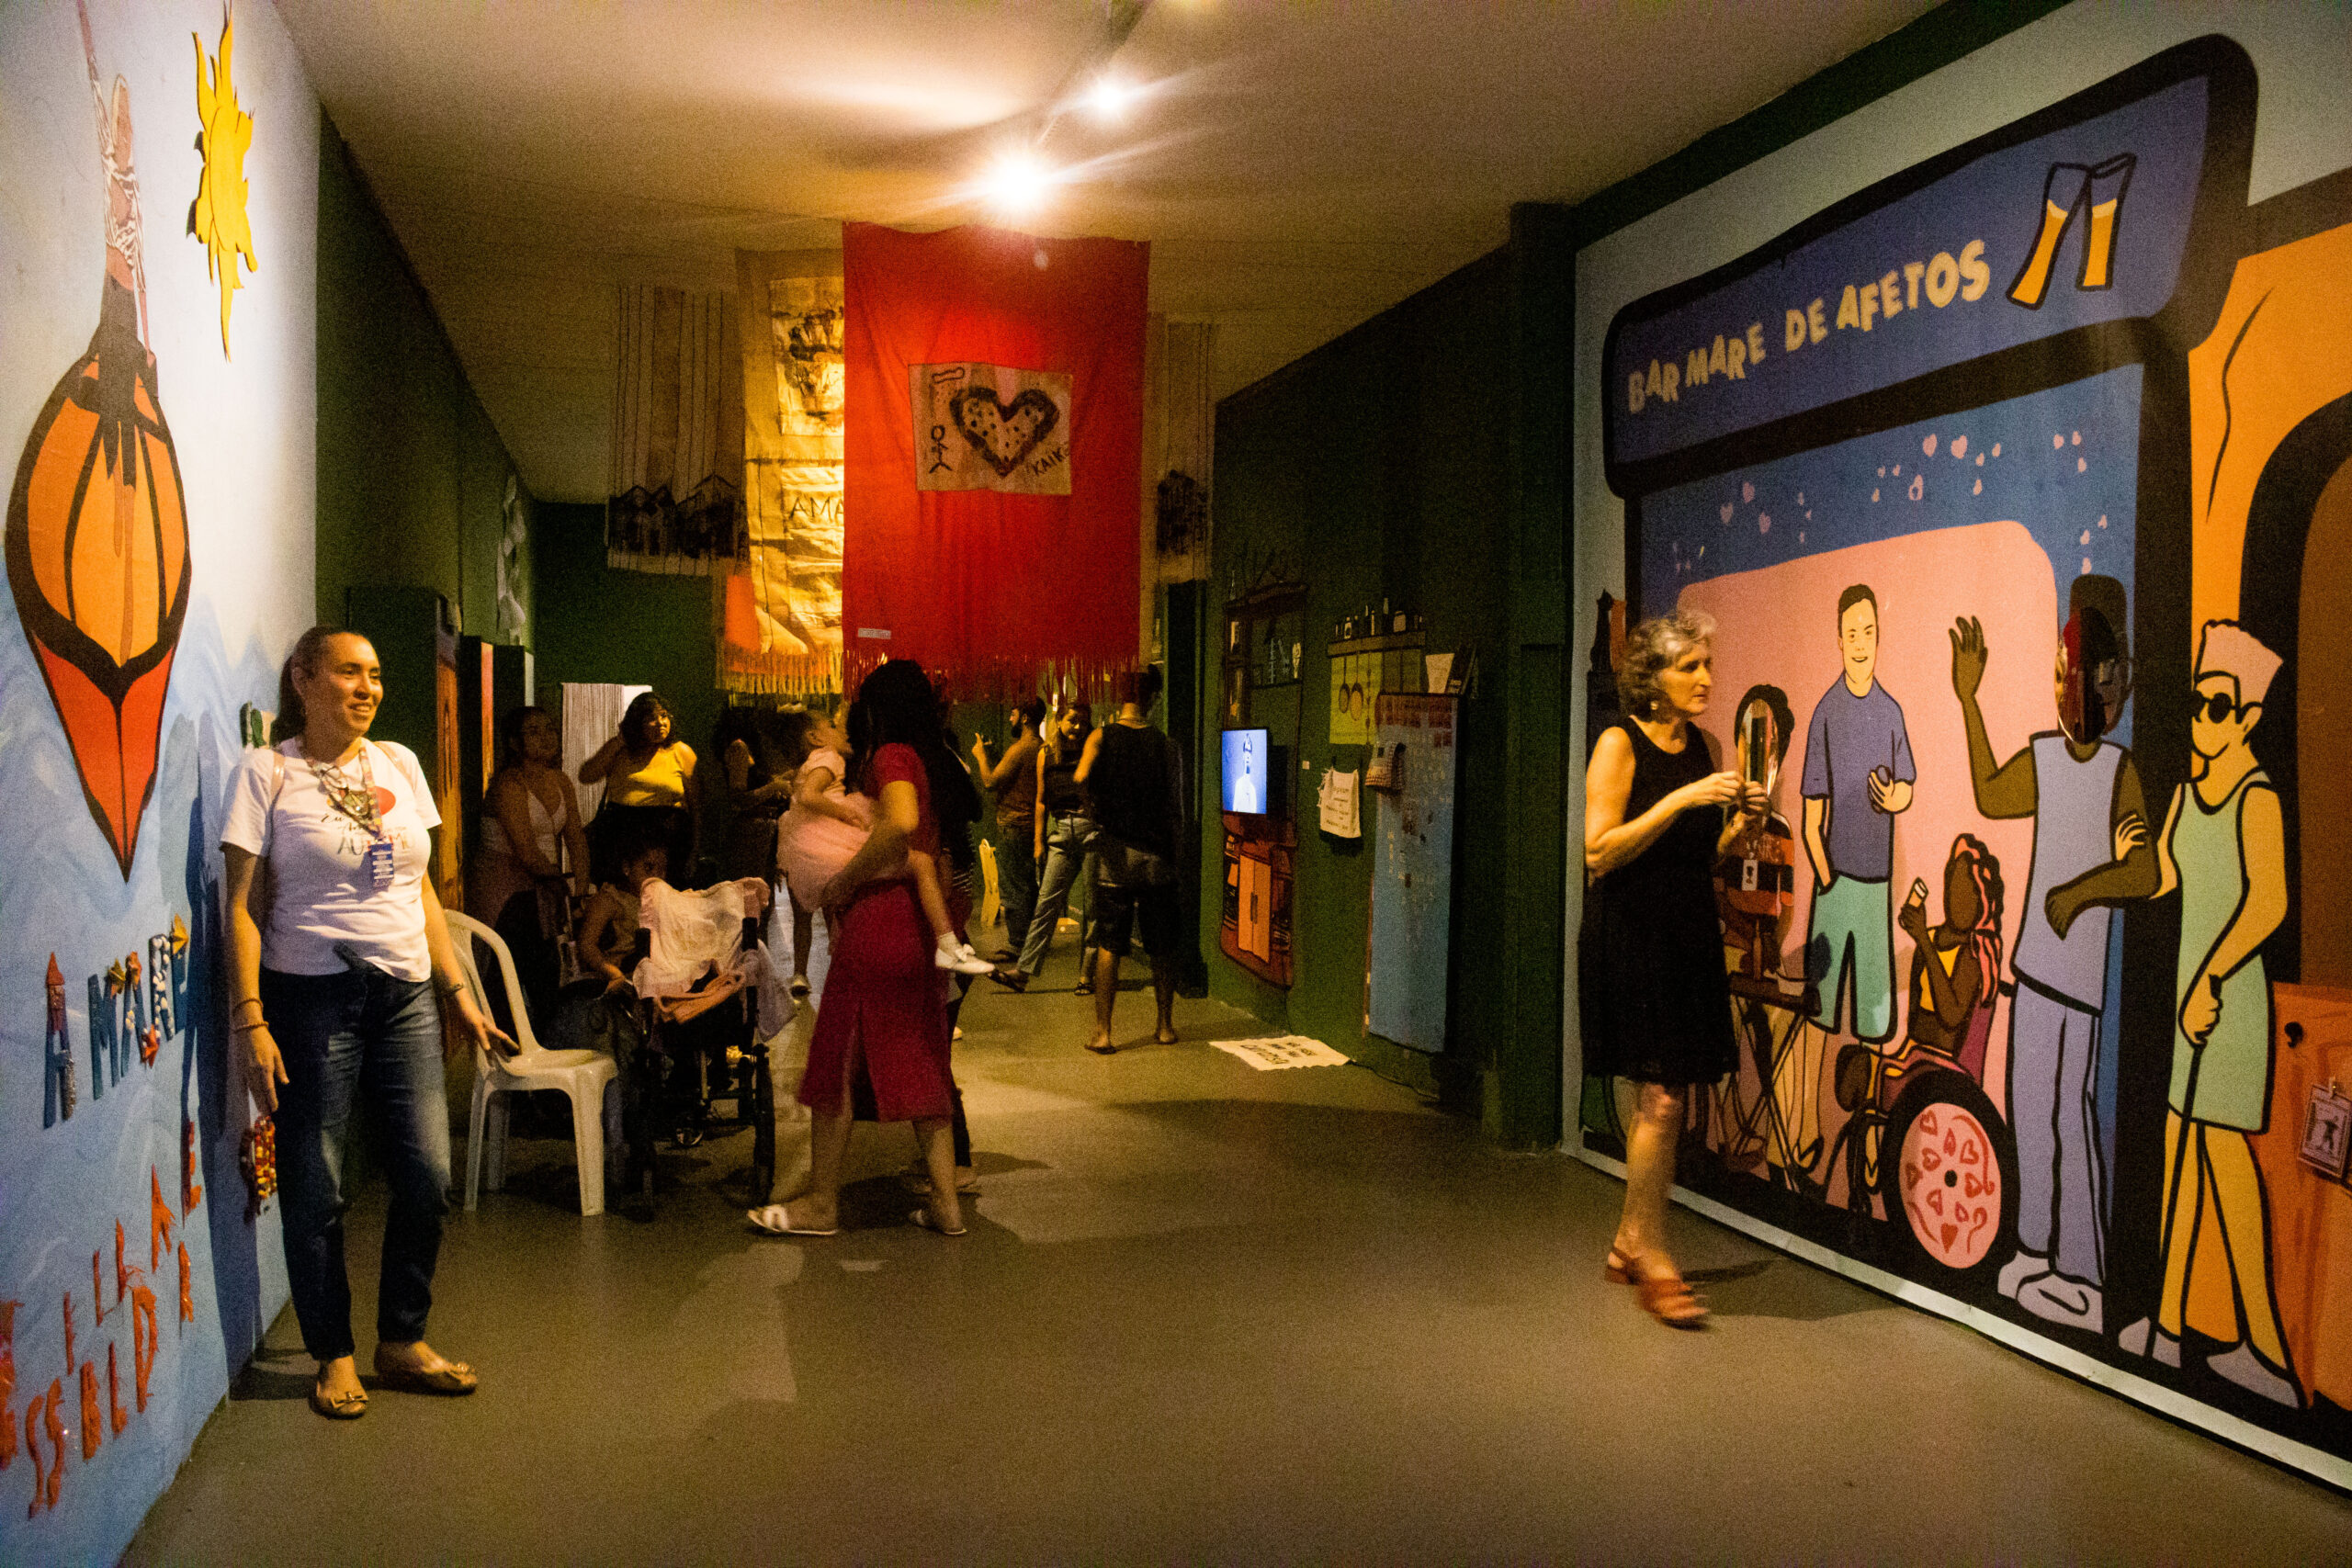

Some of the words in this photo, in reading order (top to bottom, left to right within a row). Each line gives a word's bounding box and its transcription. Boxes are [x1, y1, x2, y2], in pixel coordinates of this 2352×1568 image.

[1629, 359, 1680, 412] BAR
[1785, 297, 1828, 352] DE
[1837, 239, 1990, 332] AFETOS
